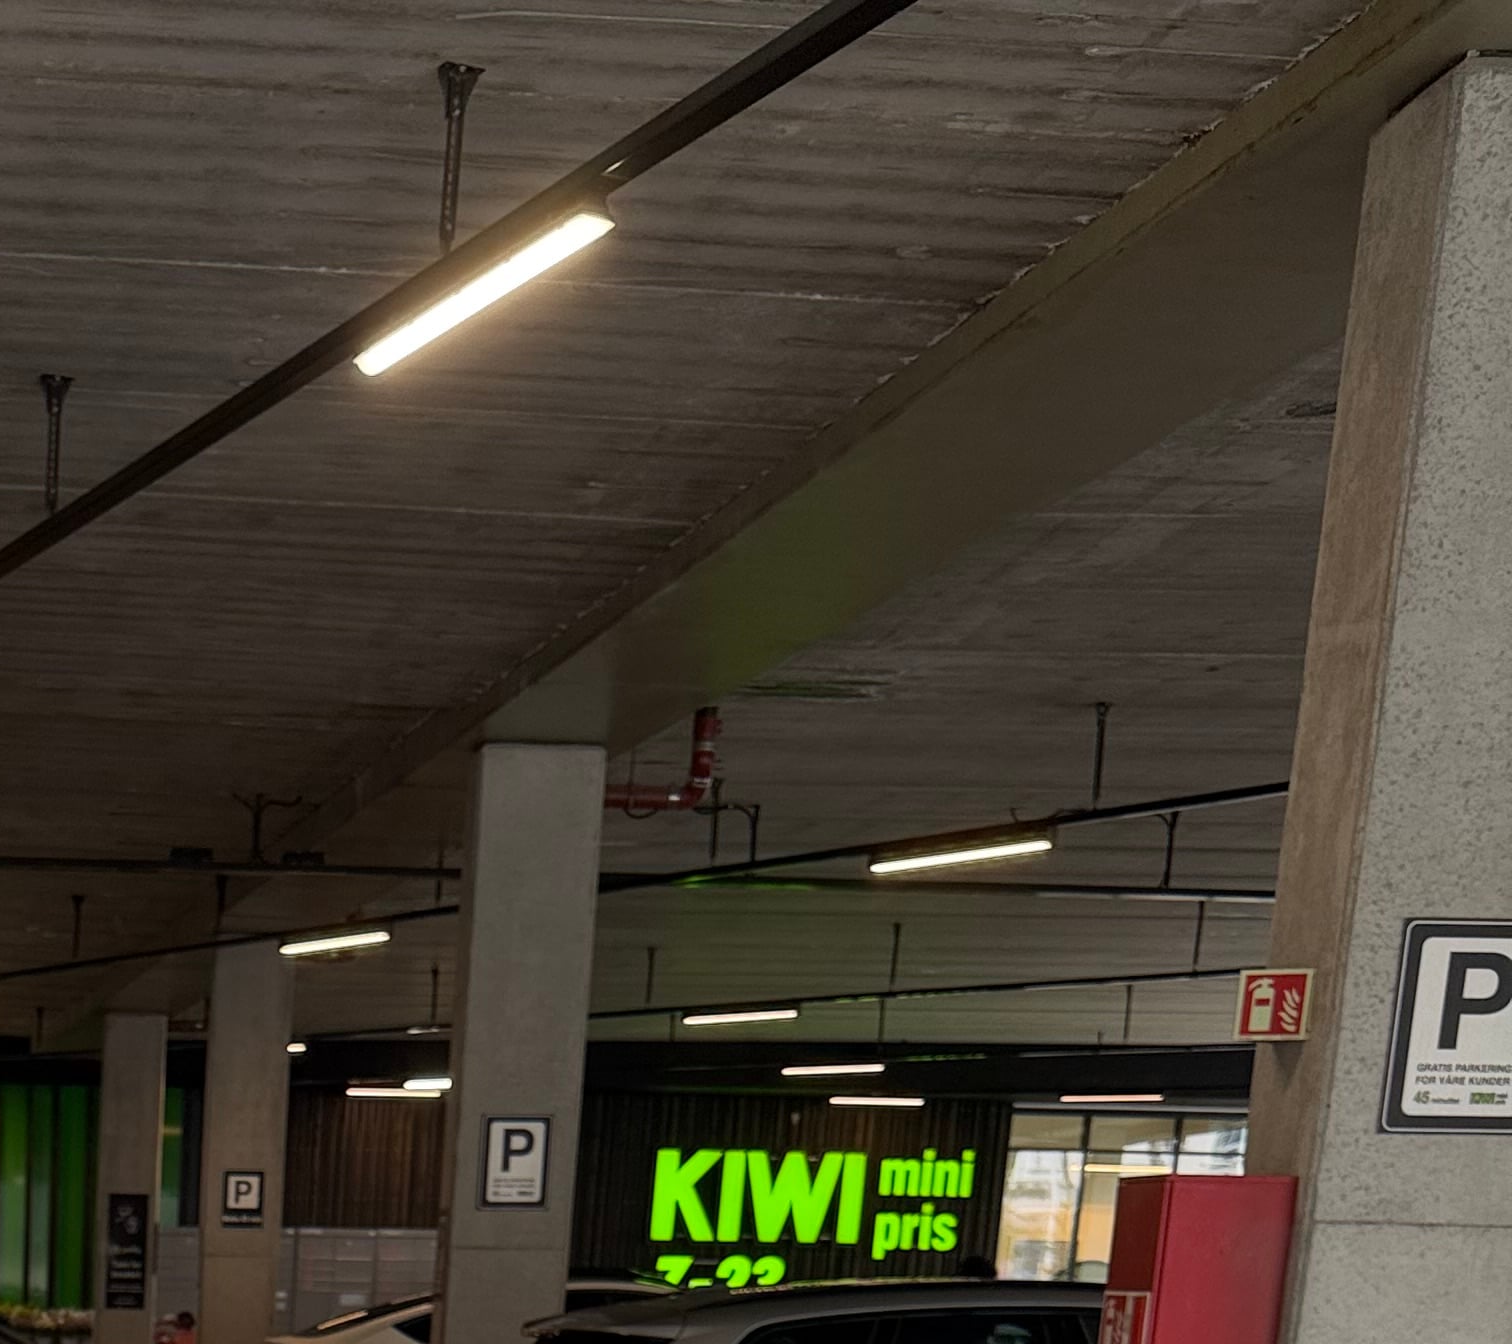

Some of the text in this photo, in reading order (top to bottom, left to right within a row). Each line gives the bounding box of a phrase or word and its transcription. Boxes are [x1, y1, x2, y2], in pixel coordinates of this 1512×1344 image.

[1437, 951, 1512, 1050] P
[1414, 1074, 1511, 1087] FOR VÅRE KUNDER
[1416, 1063, 1452, 1073] GRATIS
[1413, 1090, 1430, 1105] 45
[501, 1128, 535, 1173] P
[234, 1180, 252, 1205] P
[649, 1147, 976, 1245] KIWI mini
[871, 1201, 959, 1261] pris
